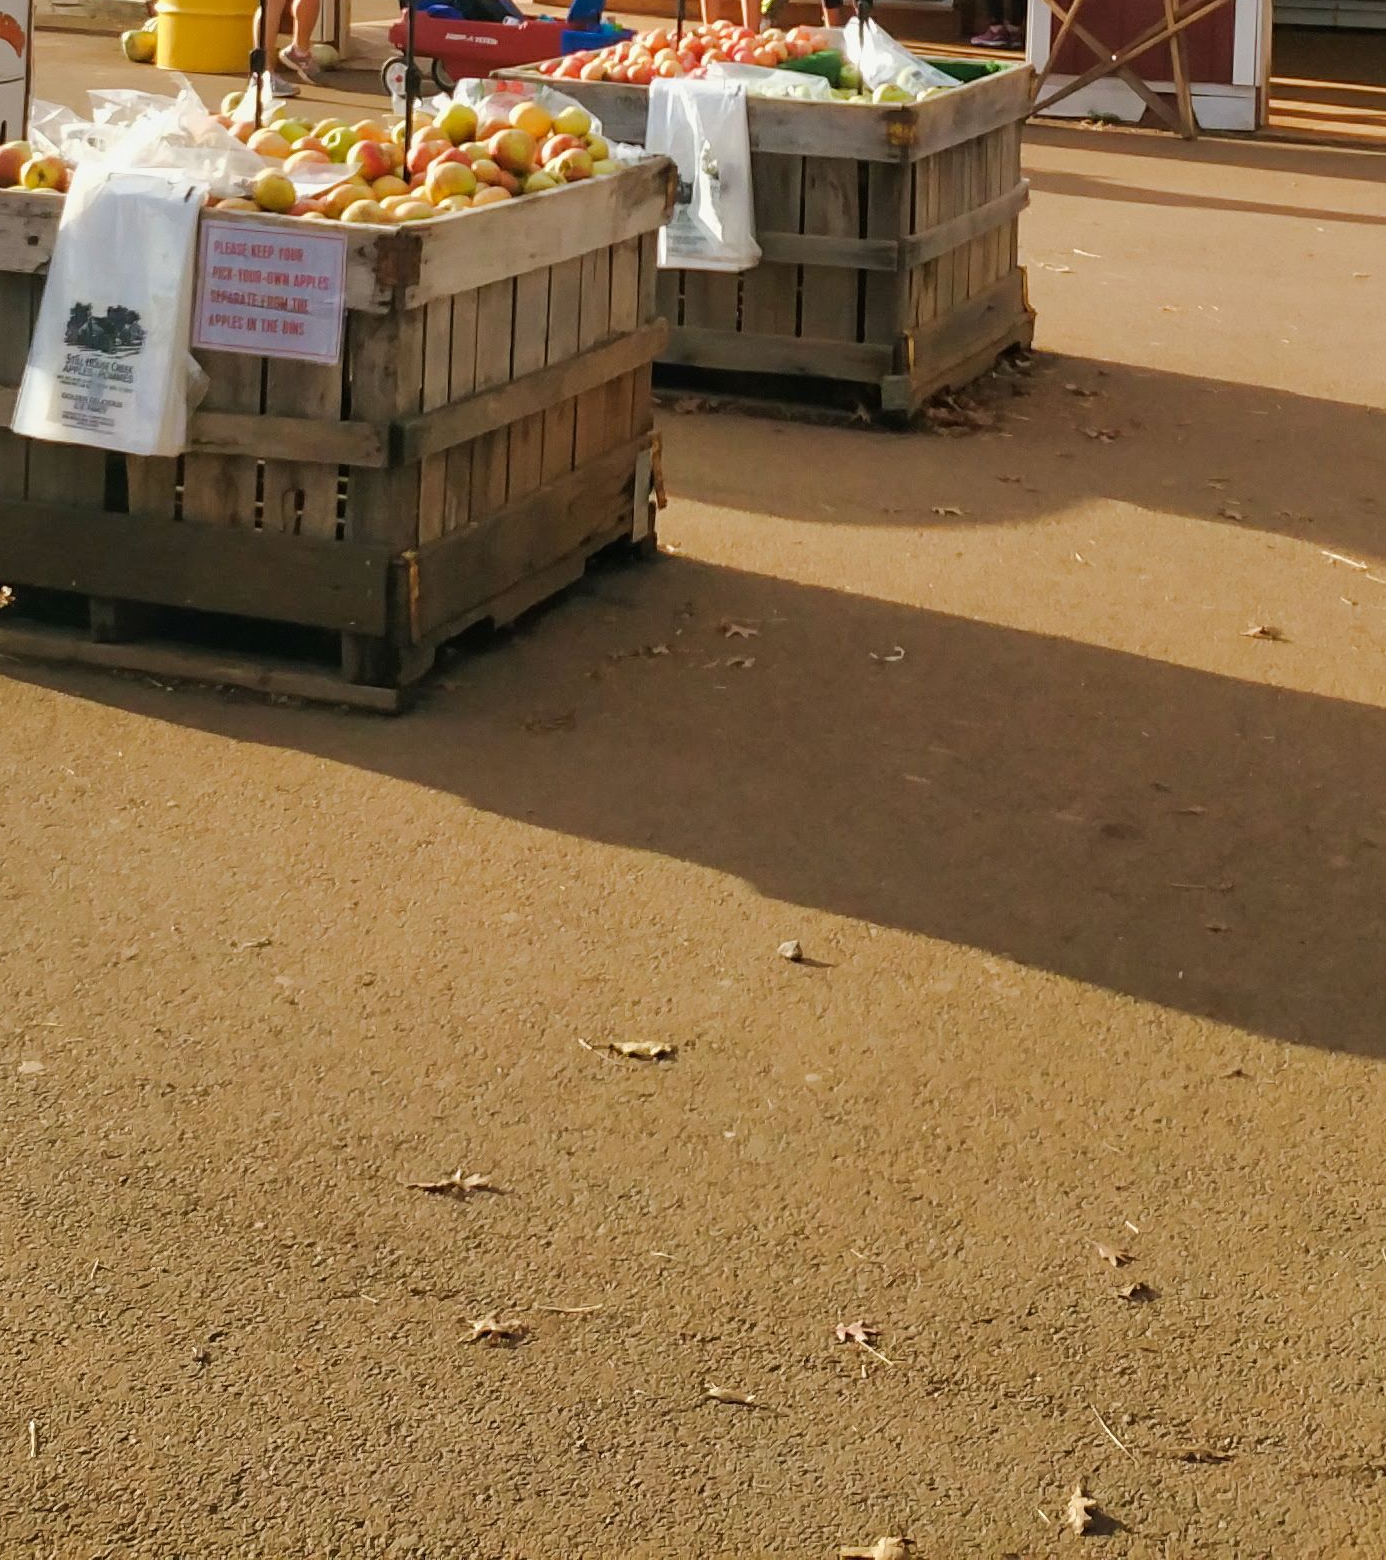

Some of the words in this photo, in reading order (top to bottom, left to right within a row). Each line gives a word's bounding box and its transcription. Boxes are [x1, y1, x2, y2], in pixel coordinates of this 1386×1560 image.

[214, 240, 247, 256] PLEASE
[251, 244, 273, 259] KEEP
[279, 247, 303, 262] YOUR
[213, 266, 290, 287] PICK-YOUR-OWN
[294, 274, 329, 290] APPLES
[211, 289, 258, 307] SEPARATE
[261, 295, 288, 311] FROM
[292, 297, 309, 314] THE
[209, 314, 243, 330] APPLES
[247, 317, 257, 331] IN
[261, 319, 278, 333] THE
[281, 321, 305, 336] BINS
